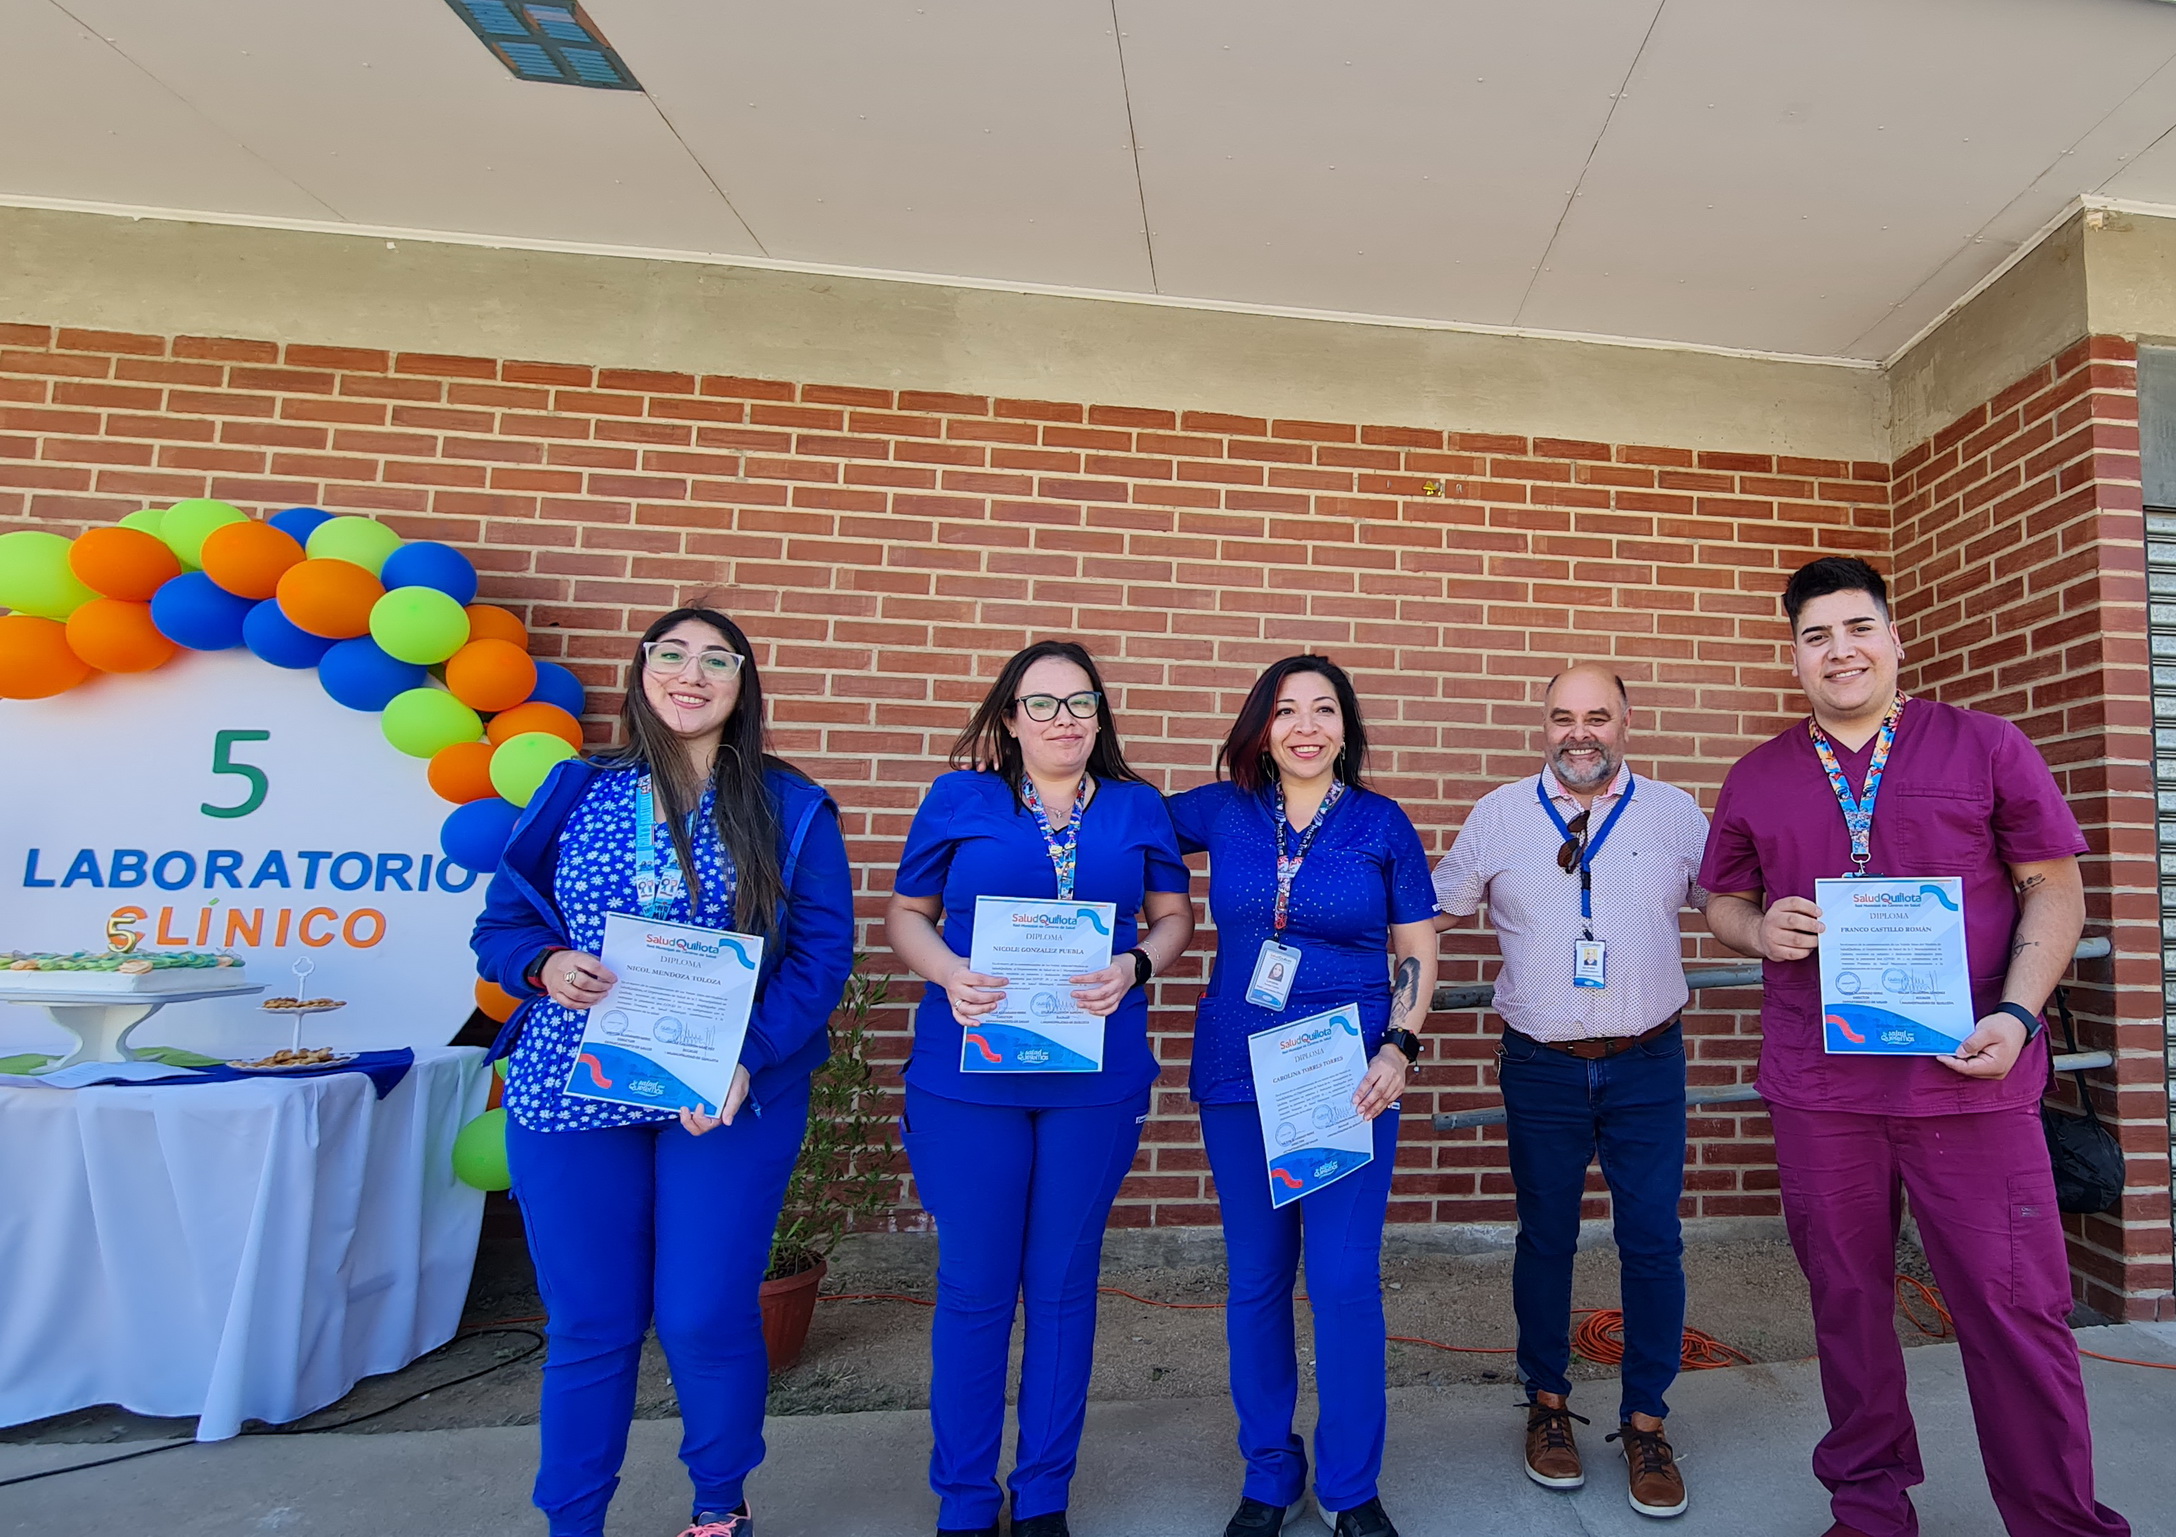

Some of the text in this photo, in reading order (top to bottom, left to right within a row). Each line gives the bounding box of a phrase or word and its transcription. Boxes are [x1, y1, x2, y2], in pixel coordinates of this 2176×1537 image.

[200, 729, 271, 819] 5
[22, 848, 479, 893] LABORATORIO
[1853, 892, 1922, 904] SaludQuillota
[1012, 913, 1078, 926] SaludQuillota
[1869, 912, 1909, 920] DIPLOMA
[107, 917, 138, 954] 5
[1025, 932, 1063, 941] DIPLOMA
[1905, 925, 1932, 933] ROMÁN
[646, 933, 719, 955] SaludQuillota
[992, 945, 1020, 953] NICOLE
[1020, 946, 1058, 954] GONZALEZ
[660, 955, 702, 969] DIPLOMA
[626, 964, 722, 986] NICOL MENDOZA TOLOZA
[1280, 1028, 1332, 1050] SaludQuillota
[1294, 1048, 1325, 1063] DIPLOMA
[1272, 1056, 1344, 1084] CAROLINA TORRES TORRES
